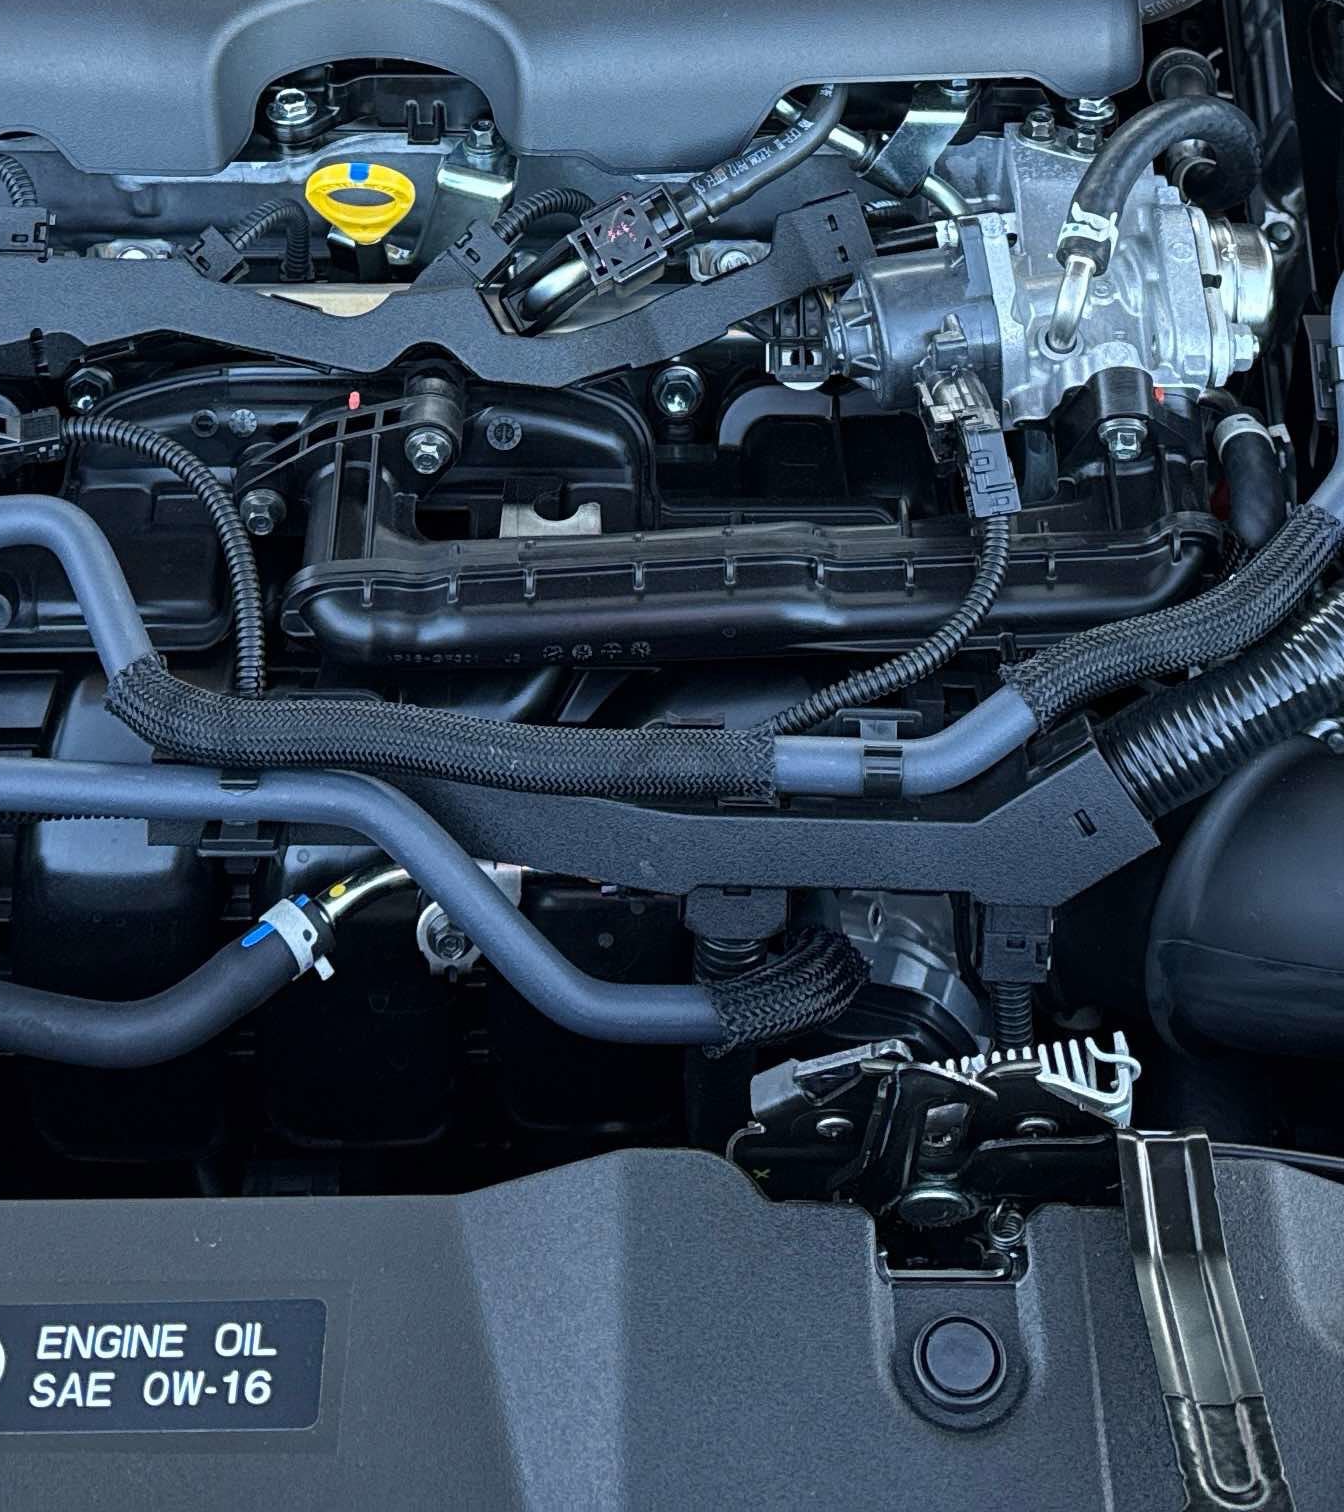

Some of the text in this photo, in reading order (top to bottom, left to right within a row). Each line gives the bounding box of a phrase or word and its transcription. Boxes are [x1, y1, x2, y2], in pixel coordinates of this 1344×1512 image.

[36, 1322, 277, 1360] ENGINE OIL
[29, 1370, 273, 1408] SAE 0W-16
